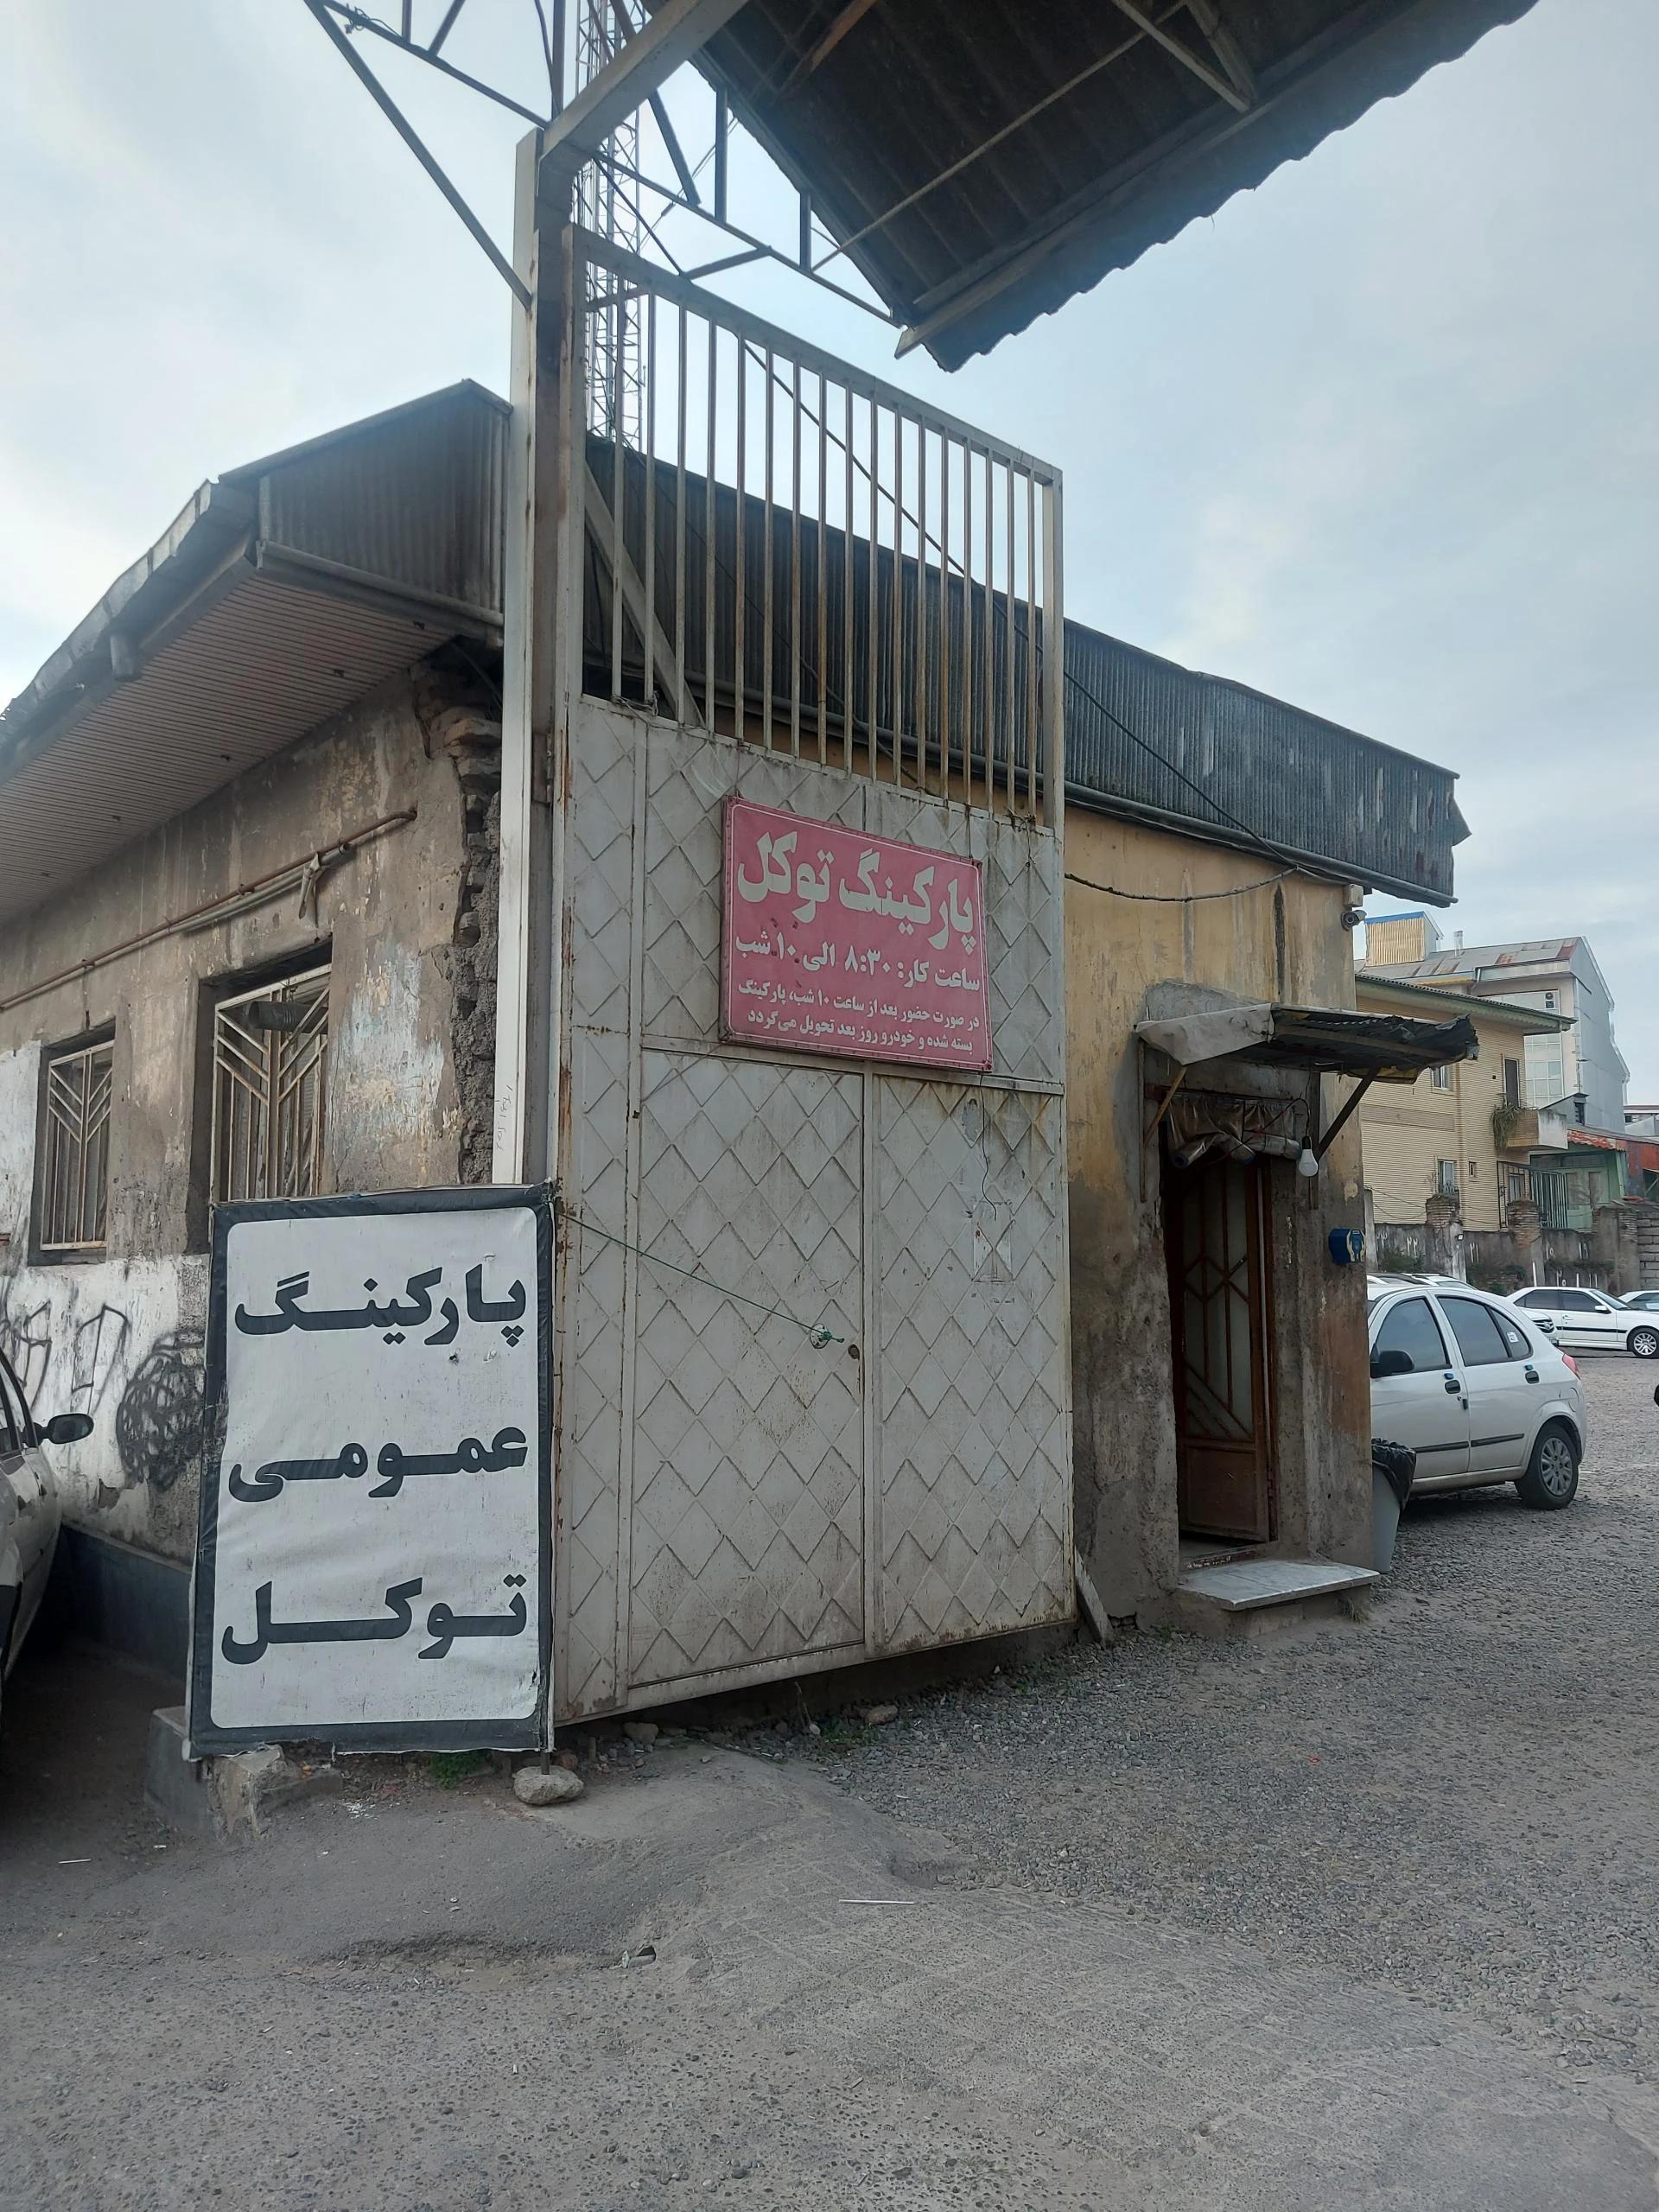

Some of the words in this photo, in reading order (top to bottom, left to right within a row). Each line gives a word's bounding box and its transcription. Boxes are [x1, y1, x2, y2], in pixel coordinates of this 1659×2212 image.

[737, 830, 835, 924] توکل
[839, 848, 976, 955] پارکینگ
[735, 931, 771, 957] شب
[777, 931, 796, 960] ۱۰
[803, 941, 836, 971] الی
[844, 944, 891, 976] ۸:۳۰
[897, 959, 930, 988] کار:
[934, 968, 980, 991] ساعت
[738, 979, 786, 1005] پارکینگ
[817, 988, 830, 1007] ۱۰
[833, 995, 865, 1011] ساعت
[867, 998, 878, 1018] از
[880, 1003, 898, 1020] بعد
[799, 1014, 835, 1036] تحویل
[900, 1006, 931, 1023] حضور
[933, 1011, 964, 1029] صورت
[968, 1016, 980, 1032] در
[836, 1024, 856, 1040] بعد
[858, 1026, 879, 1043] روز
[880, 1029, 915, 1047] خودرو
[926, 1034, 949, 1048] شده
[918, 1037, 925, 1050] و
[950, 1037, 973, 1055] بسته
[234, 1263, 527, 1348] پارکینگ
[227, 1426, 529, 1502] عمومی
[220, 1573, 528, 1664] توکل
